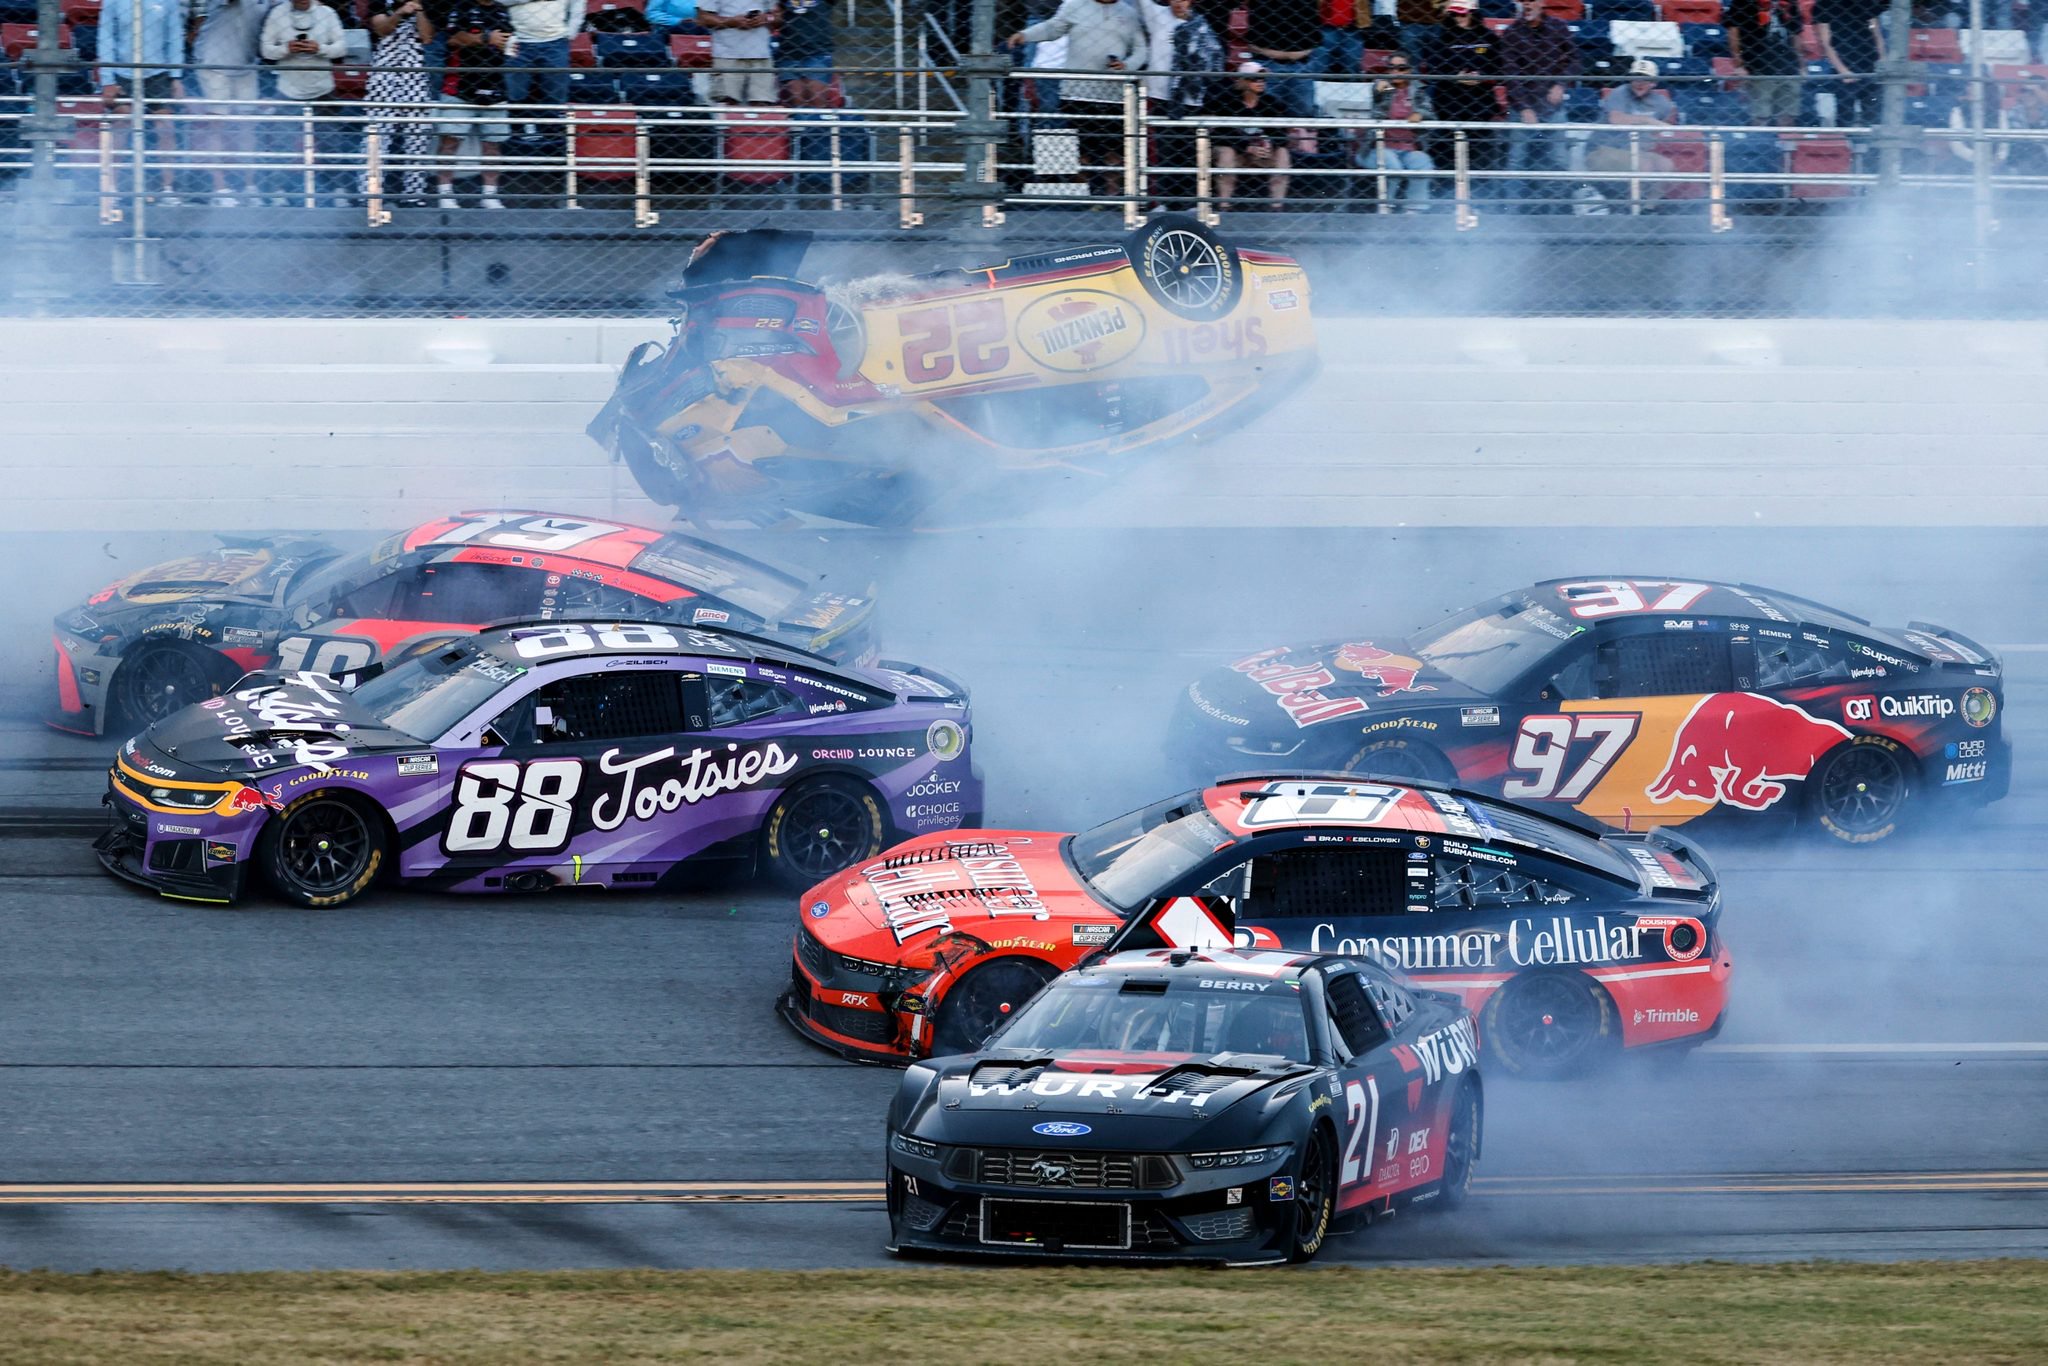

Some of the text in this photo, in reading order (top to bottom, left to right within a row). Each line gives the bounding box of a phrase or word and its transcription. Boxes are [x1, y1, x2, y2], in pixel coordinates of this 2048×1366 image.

[1038, 304, 1128, 354] PENNZOIL
[897, 297, 1010, 384] 22
[696, 610, 727, 621] Lance
[508, 624, 680, 658] 88
[1758, 629, 1792, 639] SIEMENS
[1861, 645, 1920, 673] SuperFile
[709, 666, 745, 676] SIEMENS
[1851, 666, 1875, 679] Wendy's
[794, 675, 868, 703] ROTO-ROOTER
[809, 703, 835, 715] Wendy's
[1845, 699, 1872, 721] QT
[1880, 694, 1954, 719] QuikTrip
[1361, 717, 1438, 734] GOODYEAR
[1852, 734, 1899, 753] EAGLE
[1959, 739, 1985, 749] QUAD
[812, 747, 916, 760] ORCHID LOUNGE
[1501, 714, 1640, 801] 97
[1959, 748, 1984, 758] LOCK
[289, 766, 369, 787] GOODYEAR
[1945, 761, 1987, 781] Mitti
[445, 761, 583, 851] 88
[592, 742, 799, 830] Tootsies
[906, 780, 961, 798] JOCKEY
[917, 802, 960, 816] CHOICE
[1236, 780, 1409, 829] 6
[917, 814, 960, 830] privileges
[1318, 835, 1401, 844] BRAD KESELOWSKI
[1443, 839, 1469, 850] BUILD
[1443, 846, 1517, 867] SUBMARINES.COM
[1078, 934, 1091, 942] CUP
[1310, 923, 1500, 969] Consumer
[1508, 915, 1649, 967] Cellular
[1667, 943, 1701, 960] ROUSH.COM
[1199, 979, 1271, 992] BERRY
[841, 992, 869, 1007] RFK
[1645, 1008, 1700, 1023] Trimble
[1043, 1122, 1080, 1136] Ford
[1340, 1075, 1380, 1185] 21
[1408, 1127, 1431, 1155] DEX
[904, 1176, 919, 1196] 21
